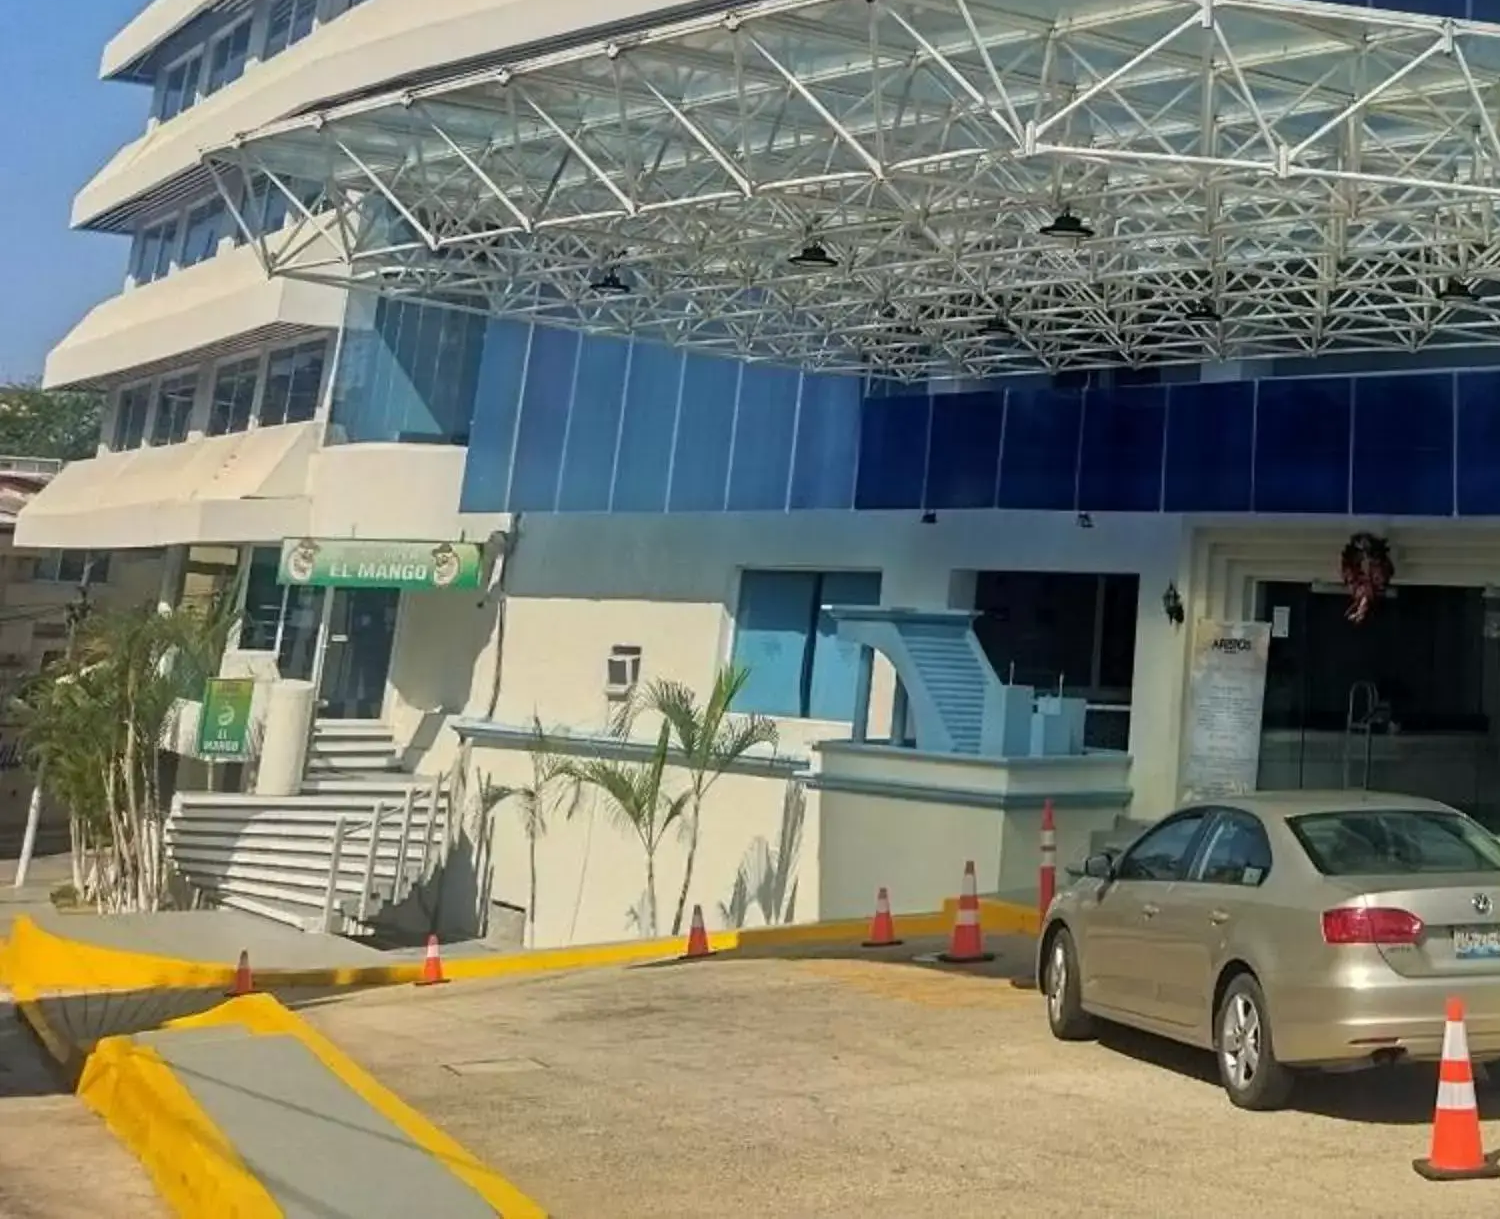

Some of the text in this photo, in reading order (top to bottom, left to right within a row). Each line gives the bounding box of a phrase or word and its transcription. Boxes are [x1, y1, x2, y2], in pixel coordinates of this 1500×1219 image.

[329, 562, 428, 582] EL MANGO
[1211, 638, 1252, 651] AROS
